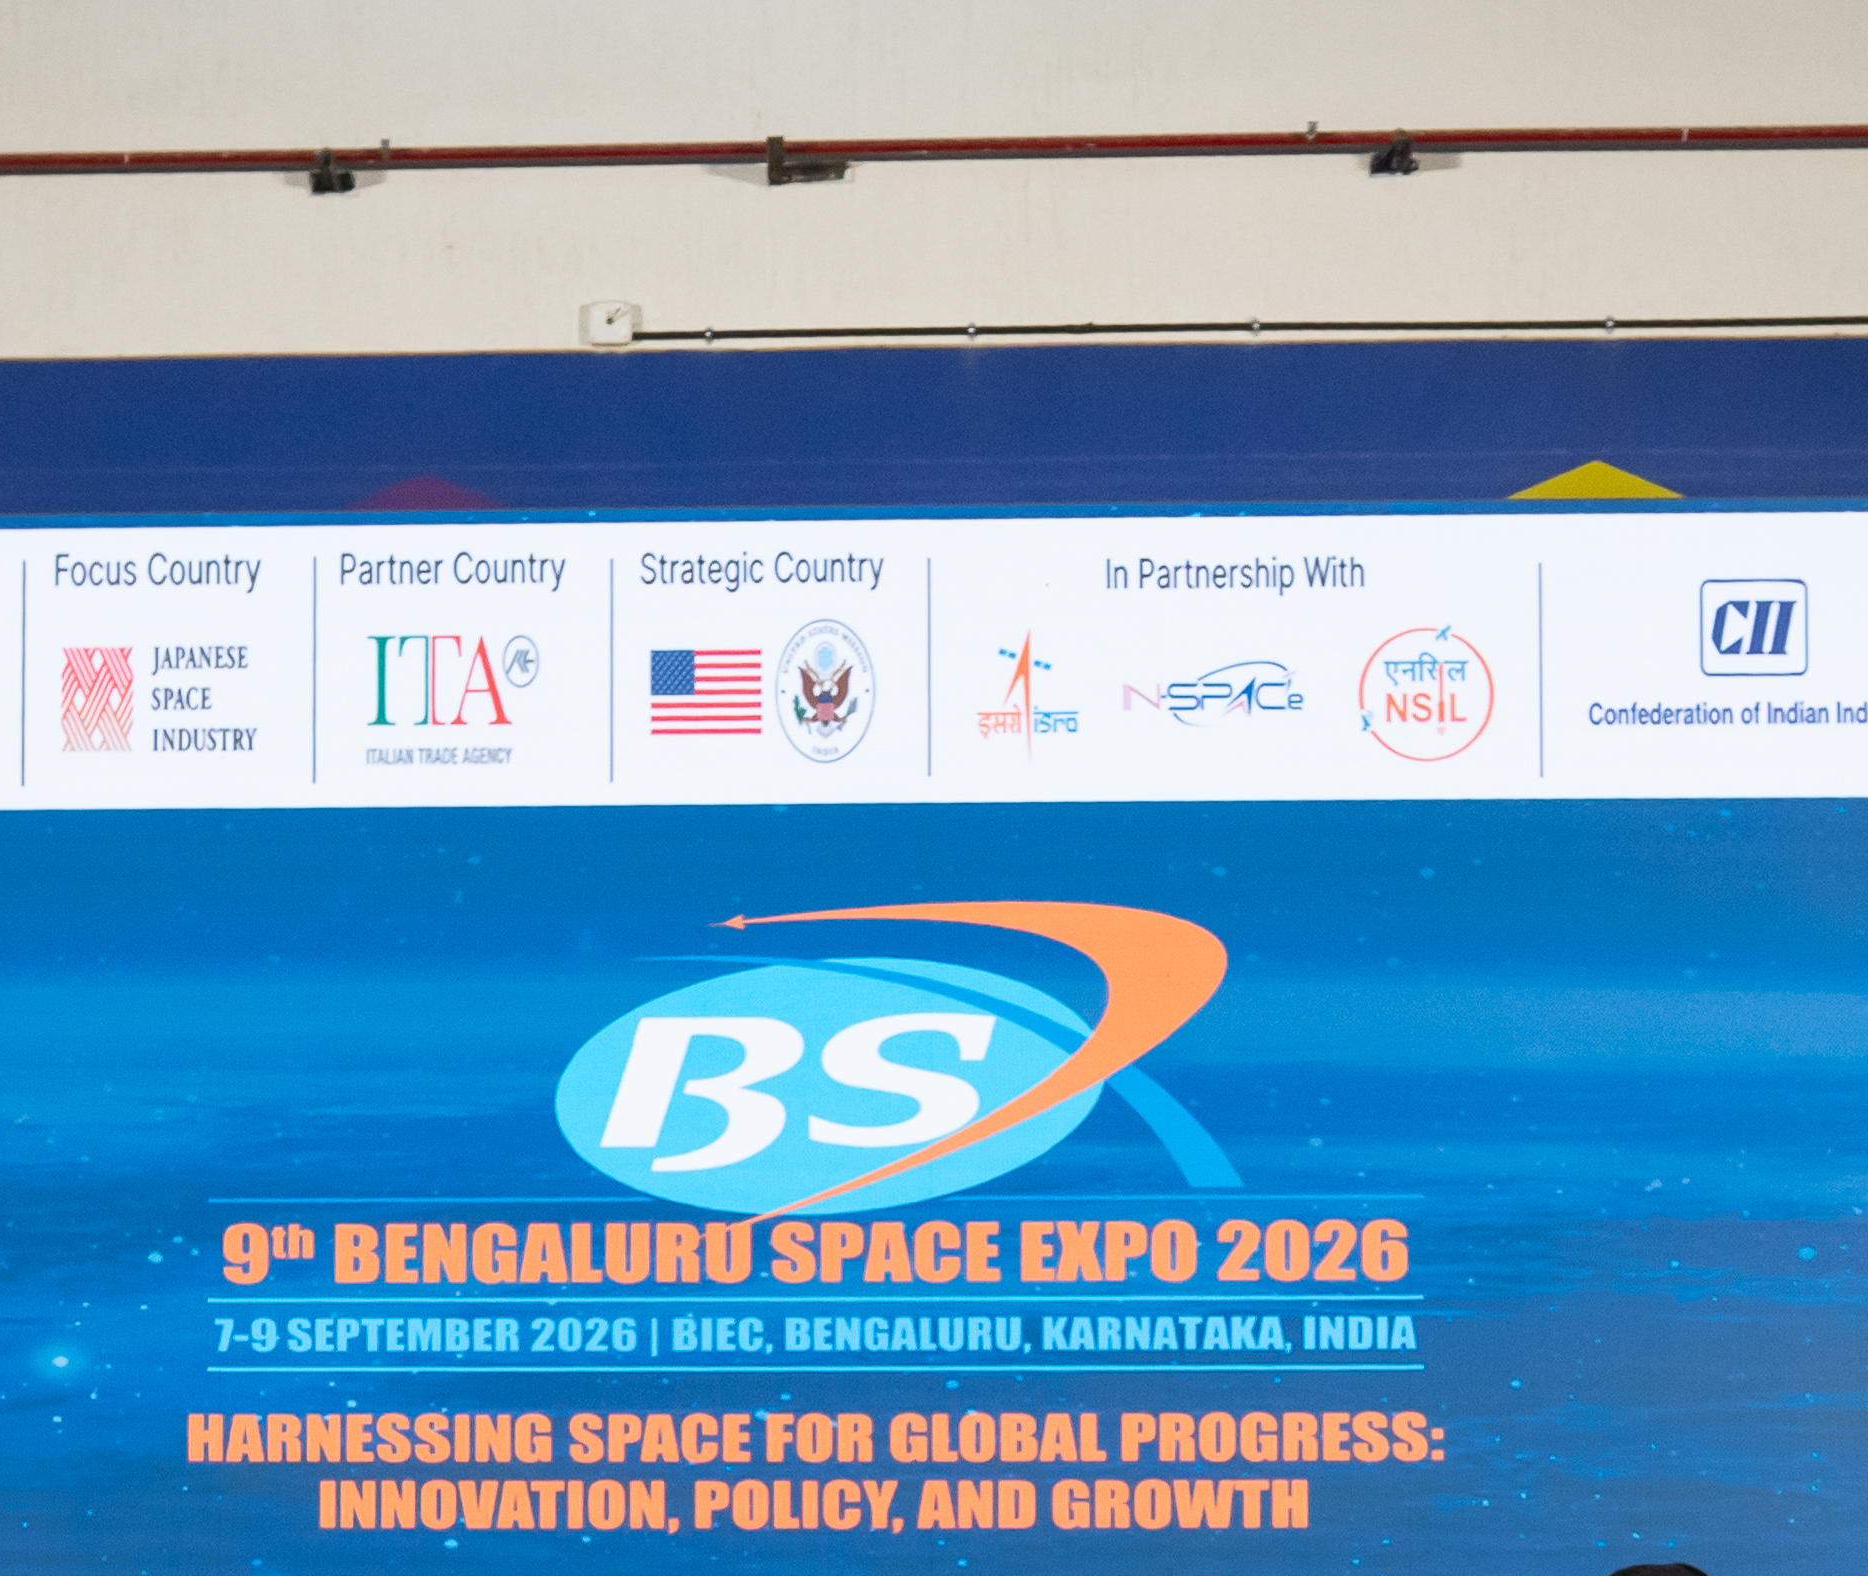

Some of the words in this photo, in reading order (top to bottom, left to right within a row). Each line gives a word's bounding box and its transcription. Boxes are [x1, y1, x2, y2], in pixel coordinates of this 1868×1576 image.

[54, 553, 137, 587] Focus
[147, 552, 261, 594] Country
[340, 552, 444, 586] Partner
[453, 551, 566, 592] Country
[640, 551, 764, 593] Strategic
[774, 550, 884, 591] Country
[1106, 558, 1128, 589] In
[1139, 556, 1295, 596] Partnership
[1303, 556, 1365, 588] With
[1711, 600, 1797, 655] CII
[151, 645, 249, 673] JAPANESE
[151, 686, 212, 711] SPACE
[366, 634, 514, 727] ITA
[1385, 692, 1468, 723] NSIL
[1588, 701, 1734, 726] Confederation
[1740, 701, 1761, 725] of
[1767, 701, 1830, 725] Indian
[153, 727, 257, 752] INDUSTRY
[366, 747, 414, 766] ITALIAN
[417, 747, 458, 765] TRADE
[461, 747, 513, 765] AGENCY
[222, 1222, 315, 1286] 9th
[334, 1221, 754, 1286] BENGALURU
[771, 1221, 1003, 1285] SPACE
[1020, 1219, 1198, 1283] EXPO
[1216, 1218, 1410, 1283] 2026
[213, 1316, 281, 1353] 7-9
[286, 1316, 520, 1354] SEPTEMBER
[529, 1316, 638, 1353] 2026
[671, 1315, 774, 1358] BIEC,
[784, 1315, 1032, 1354] BENGALURU,
[1042, 1315, 1292, 1353] KARNATAKA,
[1303, 1314, 1417, 1350] INDIA
[187, 1412, 553, 1464] HARNESSING
[568, 1412, 752, 1464] SPACE
[765, 1412, 874, 1464] FOR
[889, 1411, 1108, 1464] GLOBAL
[1120, 1410, 1445, 1463] PROGRESS:
[319, 1478, 680, 1534] INNOVATION,
[694, 1478, 905, 1534] POLICY,
[916, 1479, 1037, 1530] AND
[1051, 1478, 1309, 1531] GROWTH
